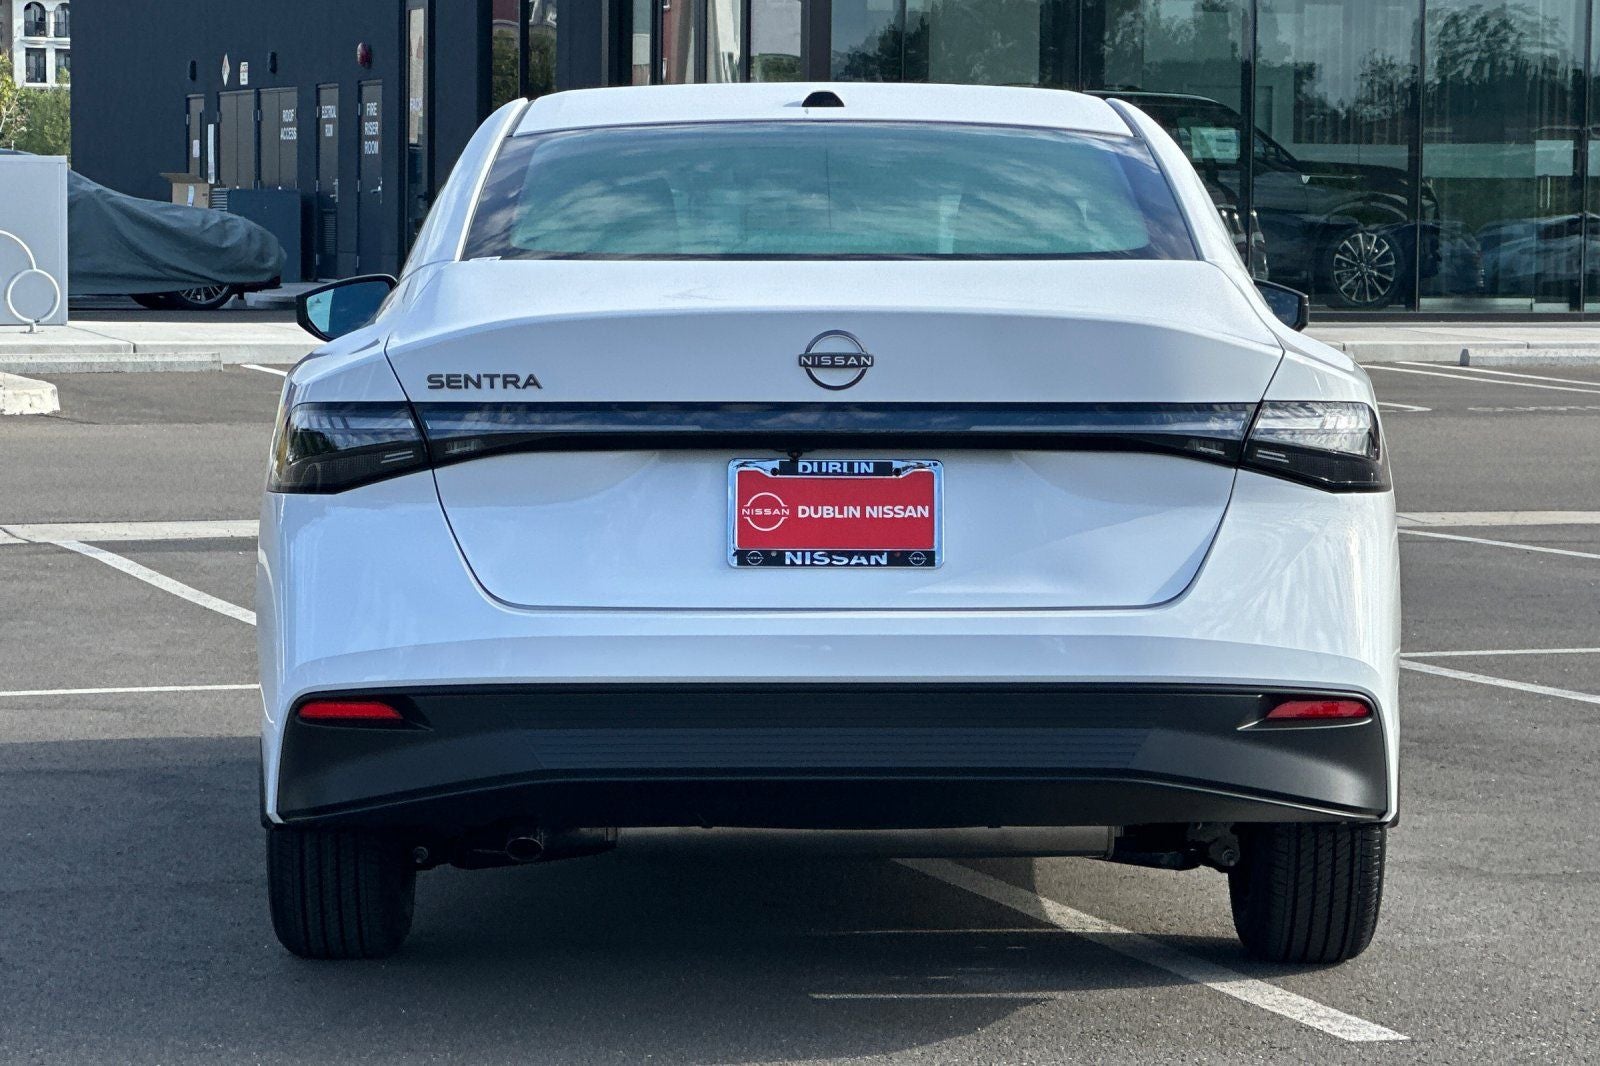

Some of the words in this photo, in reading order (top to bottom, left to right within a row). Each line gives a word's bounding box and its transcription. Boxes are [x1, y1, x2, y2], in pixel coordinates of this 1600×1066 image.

[366, 102, 377, 116] FIRE
[280, 126, 297, 140] ACCESS
[364, 121, 379, 135] RISER
[364, 140, 379, 154] ROOM
[801, 356, 872, 366] NISSAN
[427, 374, 543, 390] SENTRA
[742, 508, 790, 516] NISSAN
[798, 505, 861, 518] DUBLIN
[865, 505, 929, 518] NISSAN
[785, 551, 888, 566] NISSAN
